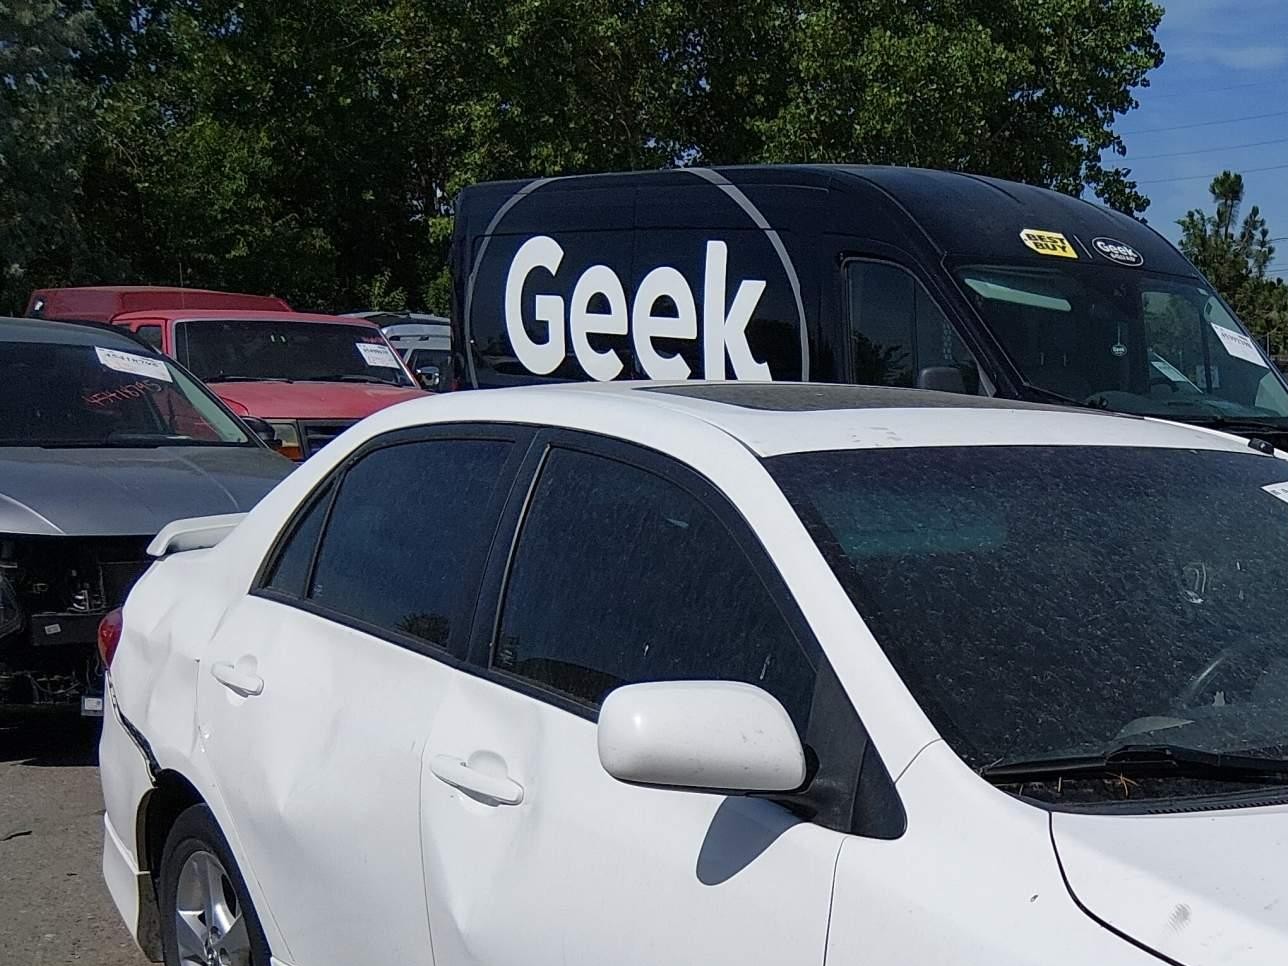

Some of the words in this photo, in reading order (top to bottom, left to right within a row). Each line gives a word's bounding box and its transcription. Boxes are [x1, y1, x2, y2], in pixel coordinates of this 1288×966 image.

[1025, 233, 1066, 246] BEST
[1033, 241, 1067, 253] BUY
[1096, 241, 1138, 258] Geek
[504, 235, 773, 381] Geek
